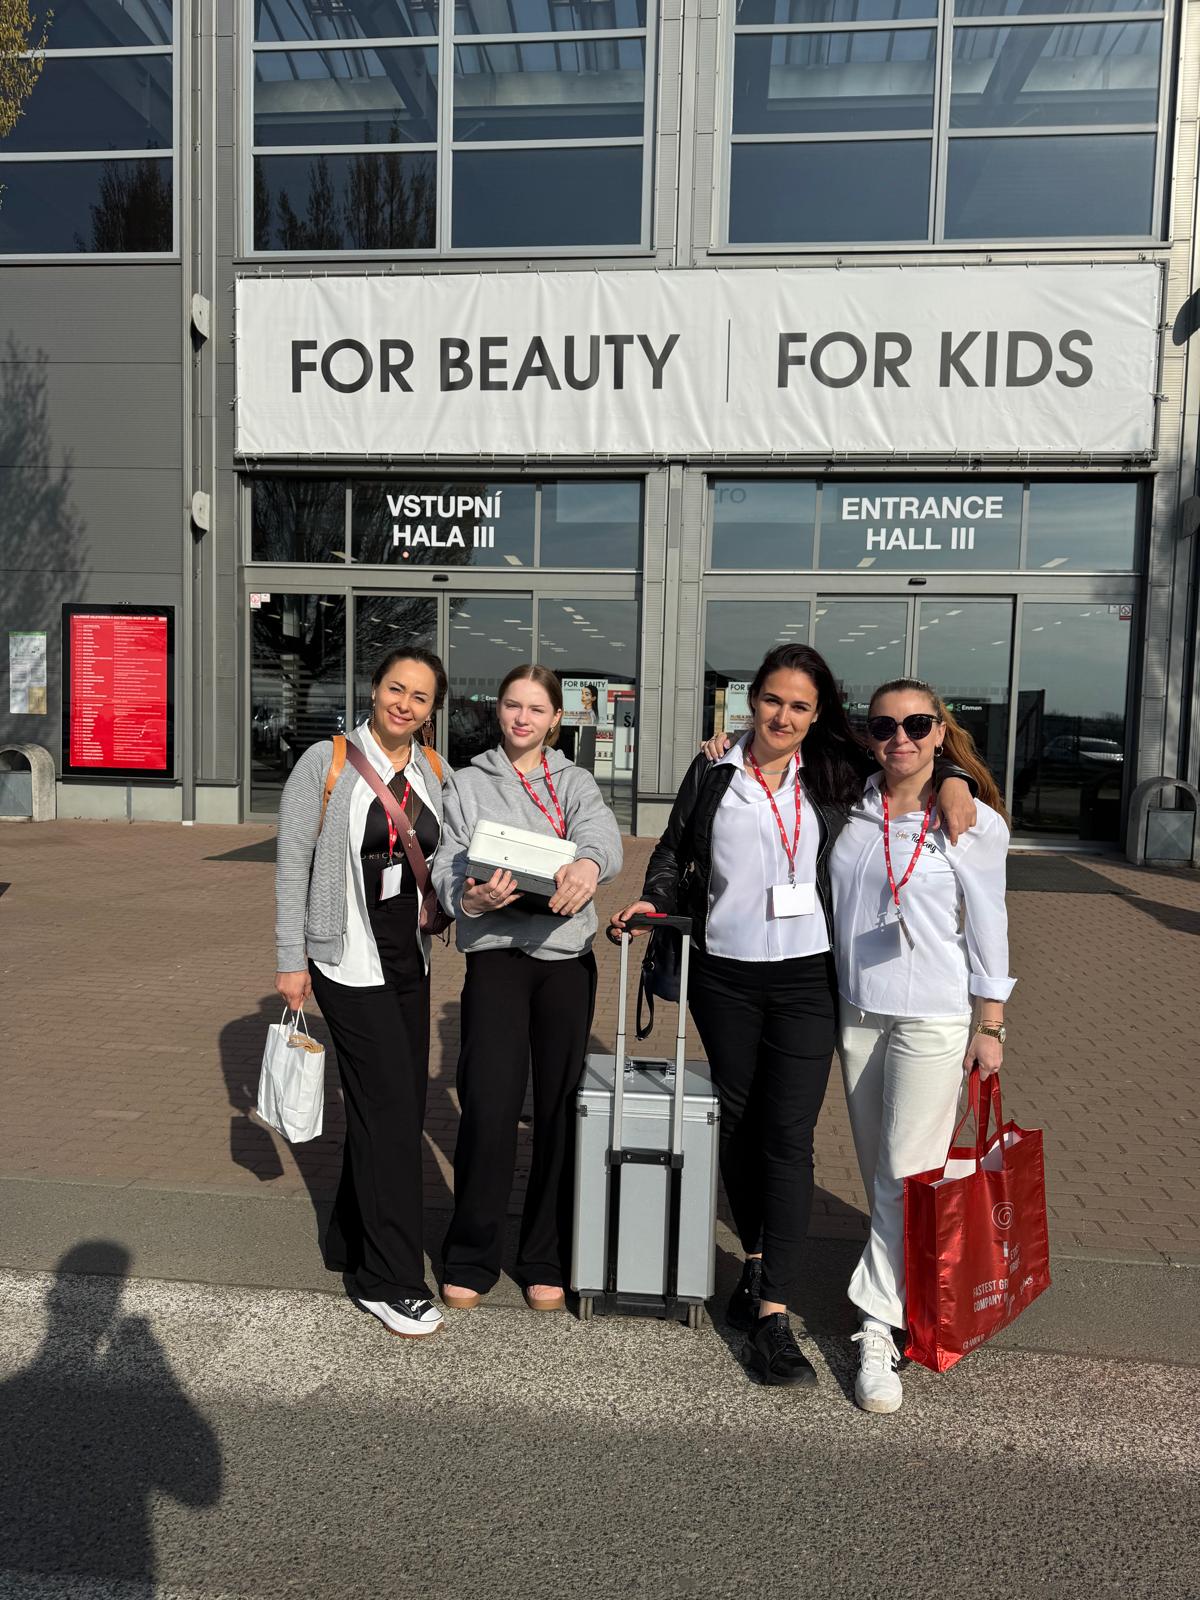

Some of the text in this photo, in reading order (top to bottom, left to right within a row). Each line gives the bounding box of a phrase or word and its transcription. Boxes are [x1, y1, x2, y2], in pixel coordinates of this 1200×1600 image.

[291, 334, 681, 394] FOR BEAUTY
[777, 329, 1093, 389] FOR KIDS
[386, 490, 503, 518] VSTUPNÍ
[842, 495, 1004, 520] ENTRANCE
[392, 525, 495, 548] HALA III
[866, 527, 975, 551] HALL III
[563, 680, 578, 688] FOR
[730, 683, 746, 691] FOR
[623, 711, 635, 728] Š
[972, 1279, 997, 1298] FASTEST
[998, 1278, 1009, 1291] GR
[973, 1293, 1002, 1313] COMPANY
